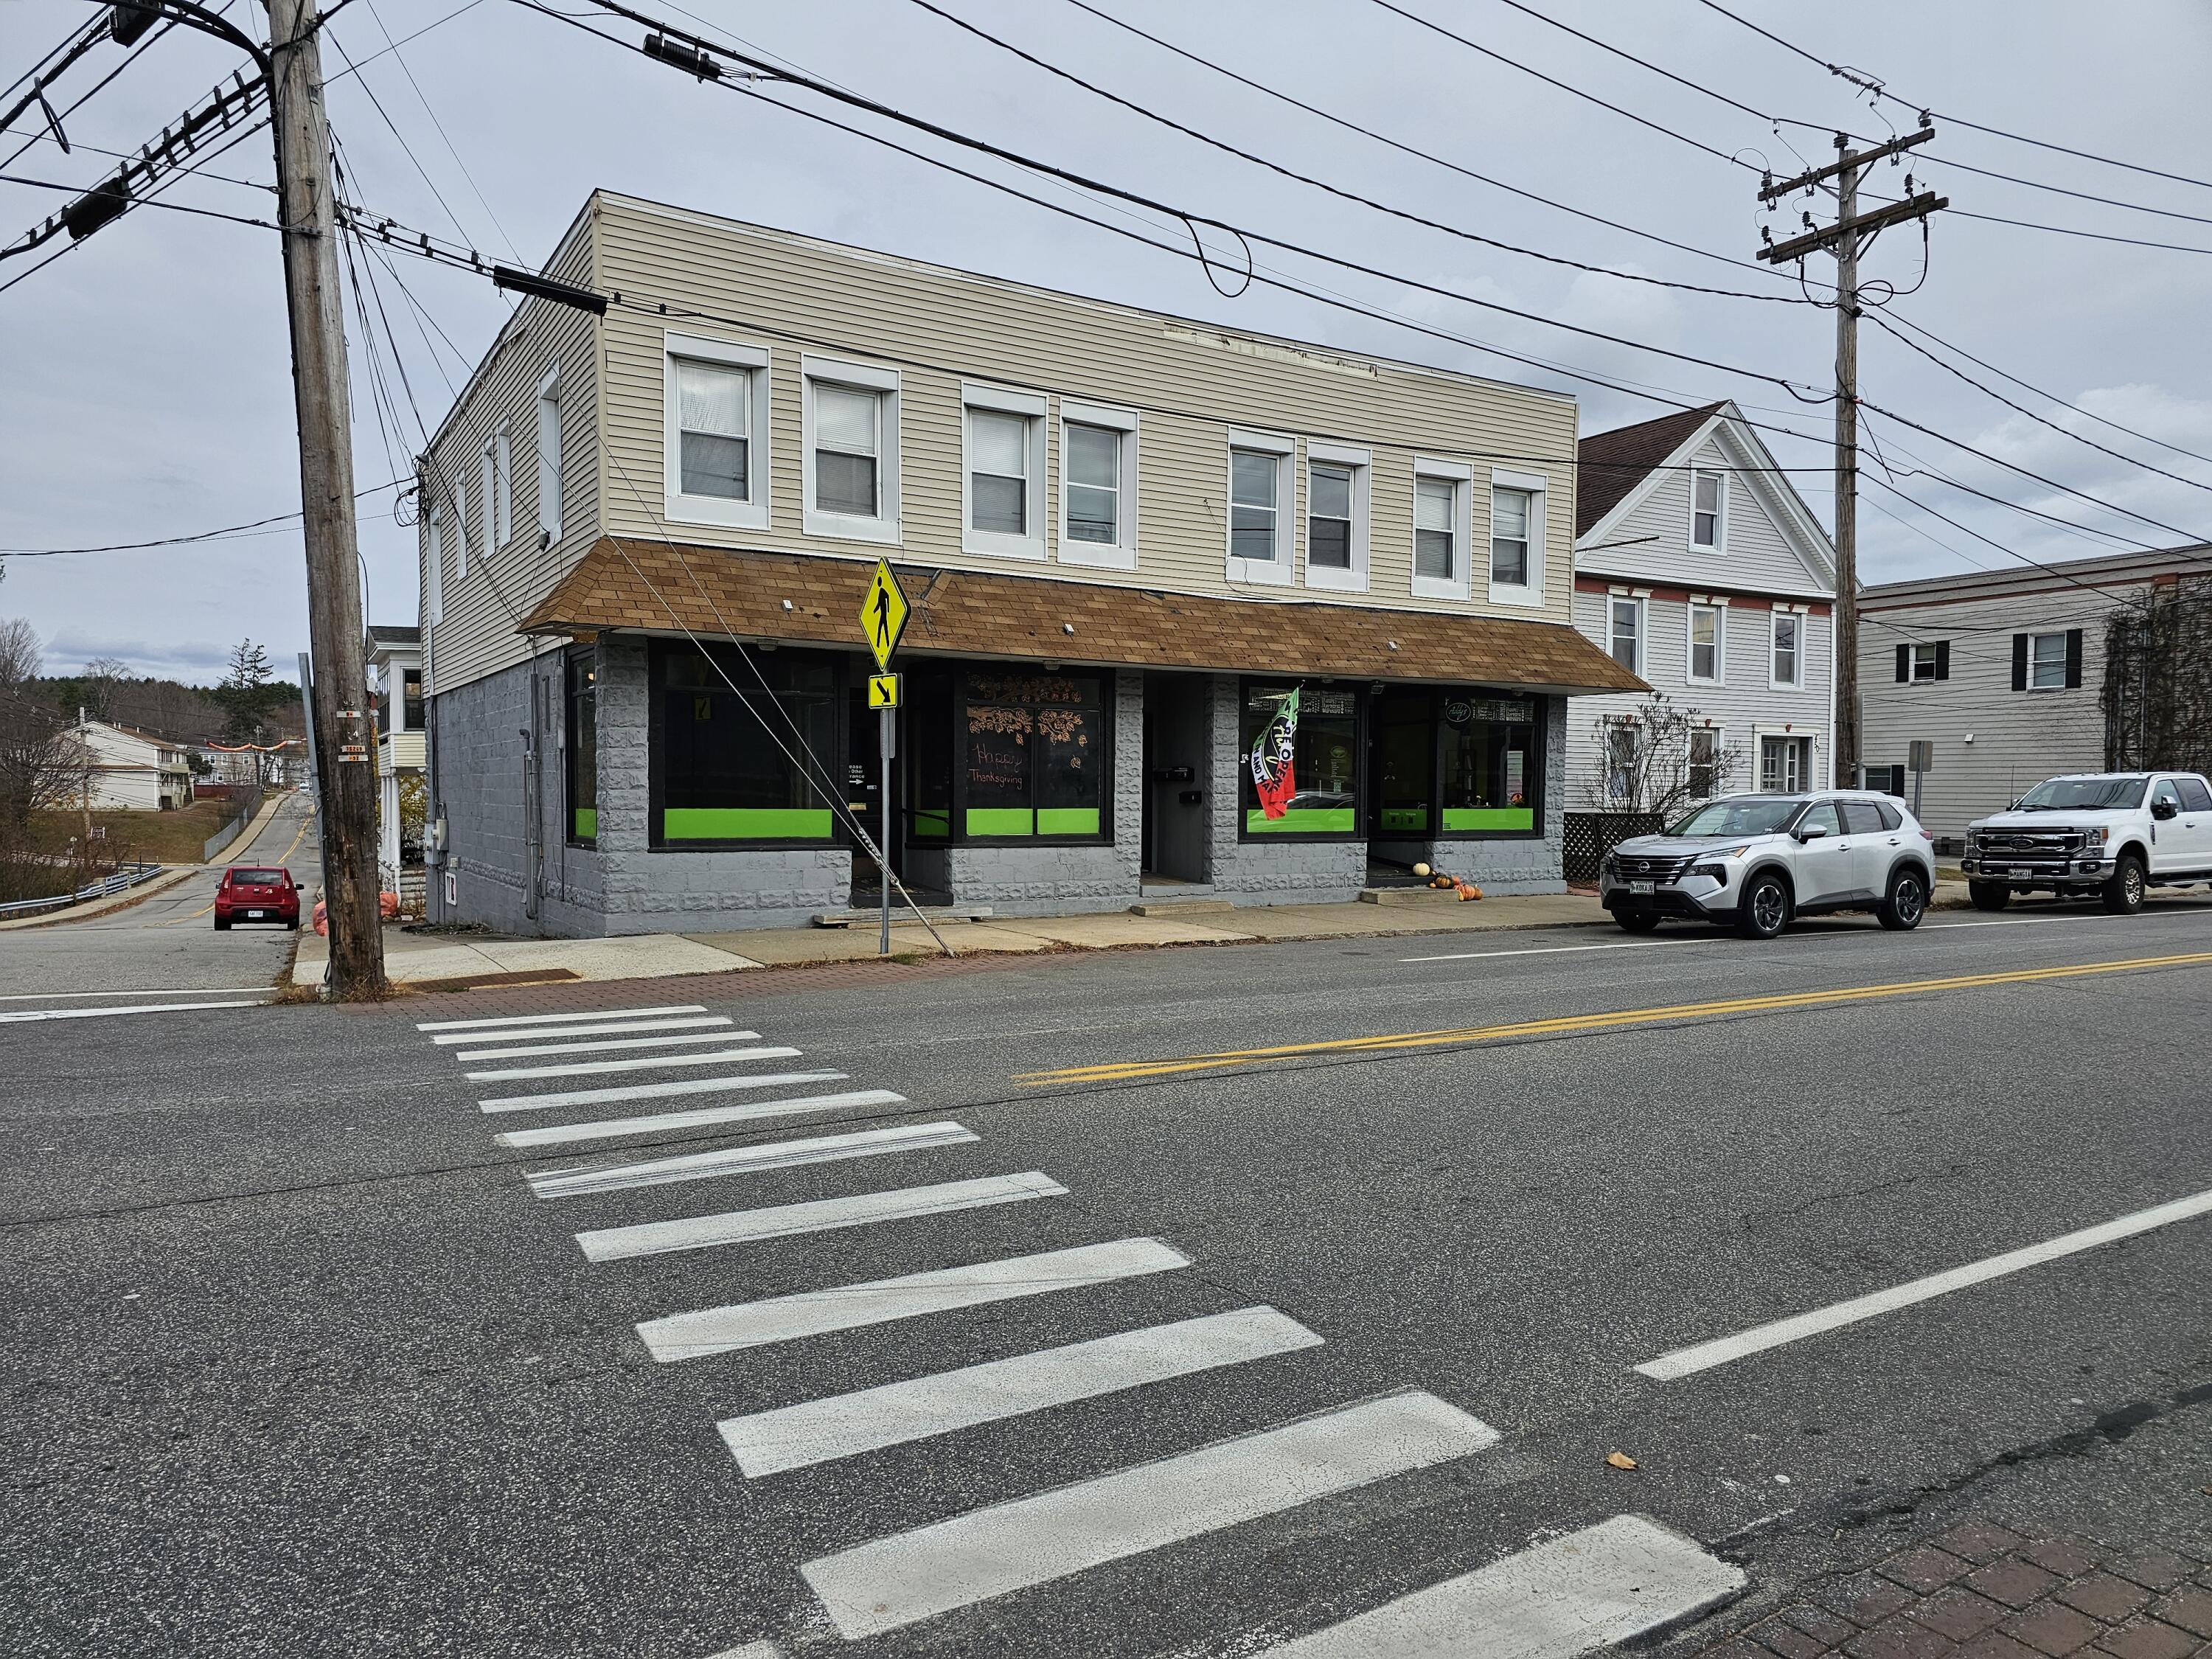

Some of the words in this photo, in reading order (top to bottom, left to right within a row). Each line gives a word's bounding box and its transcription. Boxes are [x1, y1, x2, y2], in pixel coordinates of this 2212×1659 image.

[972, 743, 1022, 773] Happy
[1253, 757, 1262, 774] AND
[968, 768, 1022, 790] Thanksgiving
